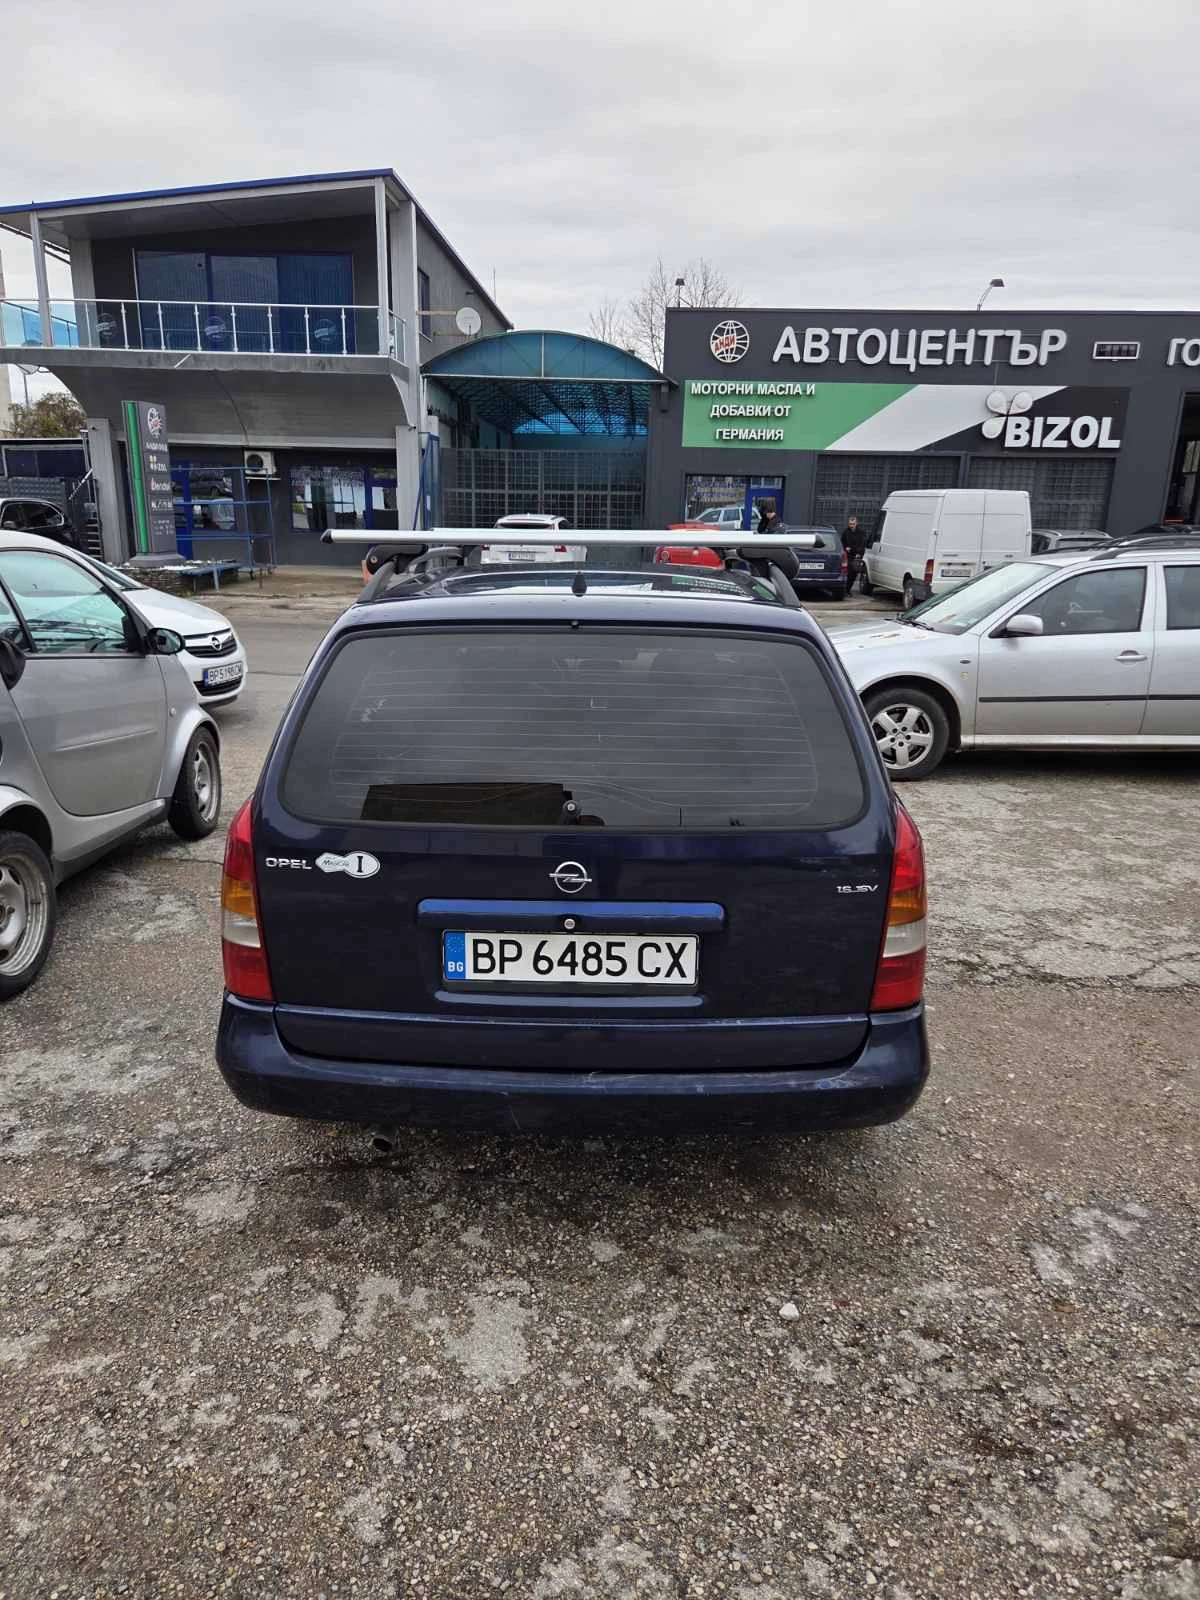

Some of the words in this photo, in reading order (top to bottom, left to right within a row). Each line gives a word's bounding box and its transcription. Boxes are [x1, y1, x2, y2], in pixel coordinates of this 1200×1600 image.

[713, 334, 736, 354] АНДИ
[772, 326, 1068, 373] АВТОЦЕНТЪР
[691, 383, 754, 395] МОТОРНИ
[757, 384, 802, 395] МАСЛА
[806, 384, 816, 395] И
[710, 405, 771, 418] ДОБАВКИ
[774, 405, 791, 417] ОТ
[715, 429, 784, 440] ГЕРМАНИЯ
[1004, 415, 1121, 448] BIZOL
[265, 857, 312, 870] OPEL
[472, 938, 523, 975] BP
[532, 940, 628, 977] 6485
[637, 942, 689, 978] CX
[447, 961, 464, 972] BG
